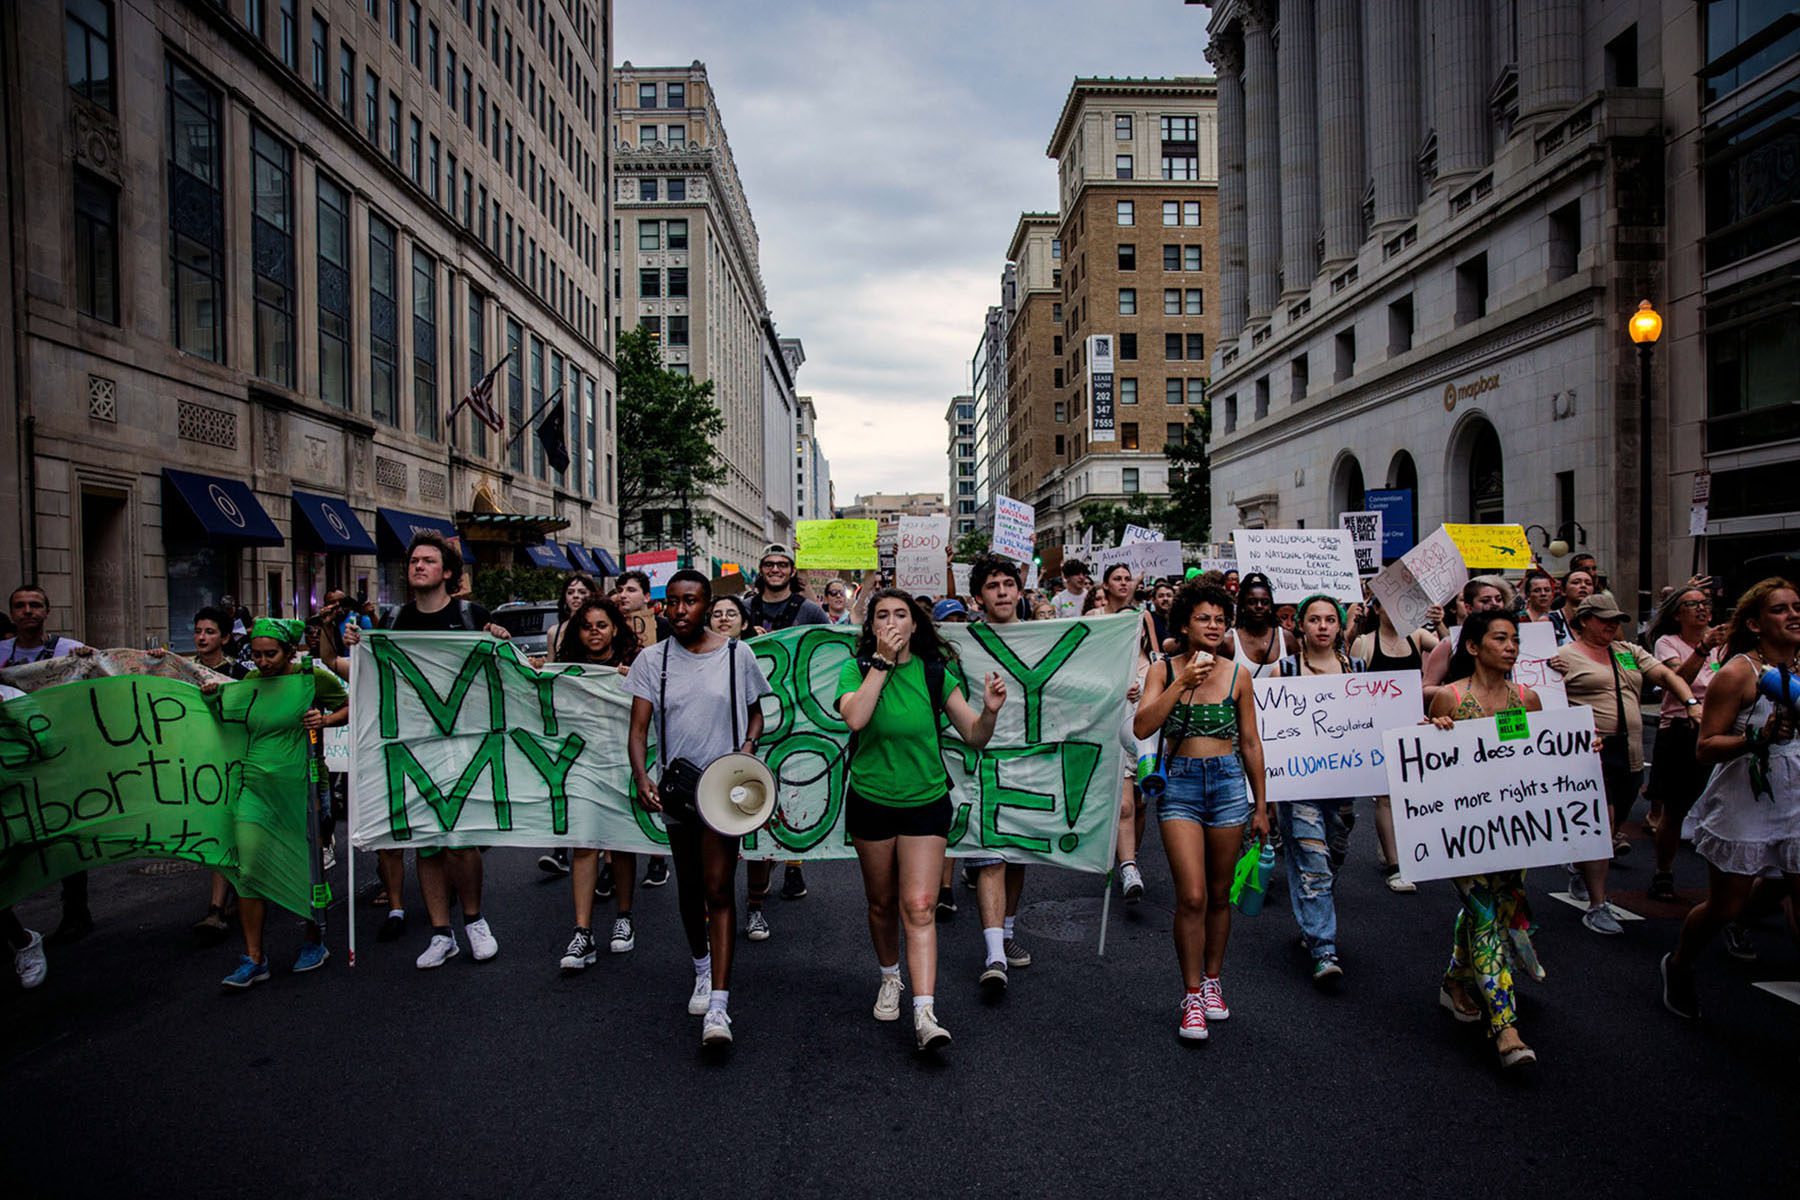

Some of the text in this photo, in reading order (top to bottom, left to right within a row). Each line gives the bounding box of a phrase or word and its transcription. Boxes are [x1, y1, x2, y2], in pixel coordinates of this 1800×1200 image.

[1458, 374, 1500, 400] mapbox
[1096, 392, 1111, 400] 202
[1096, 406, 1111, 414] 347
[1094, 419, 1114, 428] 7555
[1344, 514, 1378, 525] WE WON'T
[1127, 526, 1158, 542] FUCK
[1356, 524, 1376, 532] BACK
[902, 534, 940, 549] BLOOD
[1248, 535, 1260, 543] NO
[1358, 531, 1376, 541] WILL
[1250, 551, 1260, 559] NO
[1354, 548, 1372, 558] IGHT
[1307, 560, 1331, 568] LEAVE
[899, 572, 940, 587] SCOTUS
[370, 634, 586, 738] MY
[1253, 678, 1402, 716] Why are GUNS
[90, 681, 186, 747] Up
[1262, 710, 1374, 741] Less Regulated
[1500, 724, 1514, 734] HELL
[1288, 748, 1363, 776] WOMEN'S
[1398, 736, 1459, 783] How
[1473, 736, 1516, 763] does
[1523, 745, 1534, 756] a
[1537, 729, 1592, 756] GUN
[384, 726, 586, 841] MY
[1405, 775, 1598, 820] have more rights than
[1414, 798, 1602, 862] a WOMAN!?!
